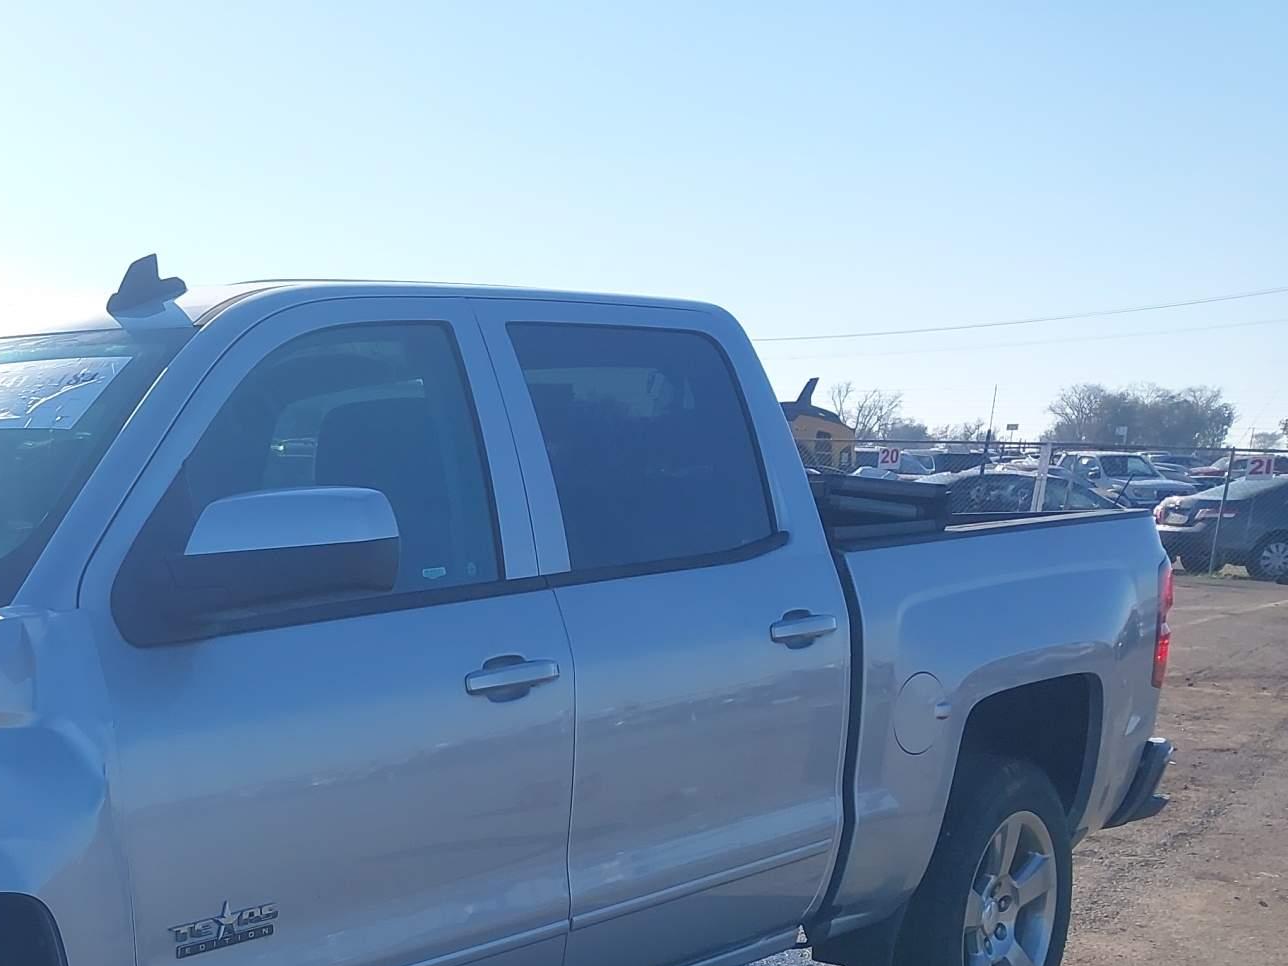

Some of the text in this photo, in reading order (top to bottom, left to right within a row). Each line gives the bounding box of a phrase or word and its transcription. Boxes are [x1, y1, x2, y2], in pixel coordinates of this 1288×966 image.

[880, 448, 899, 464] 20
[1249, 458, 1272, 475] 21
[184, 927, 271, 955] EDITION
